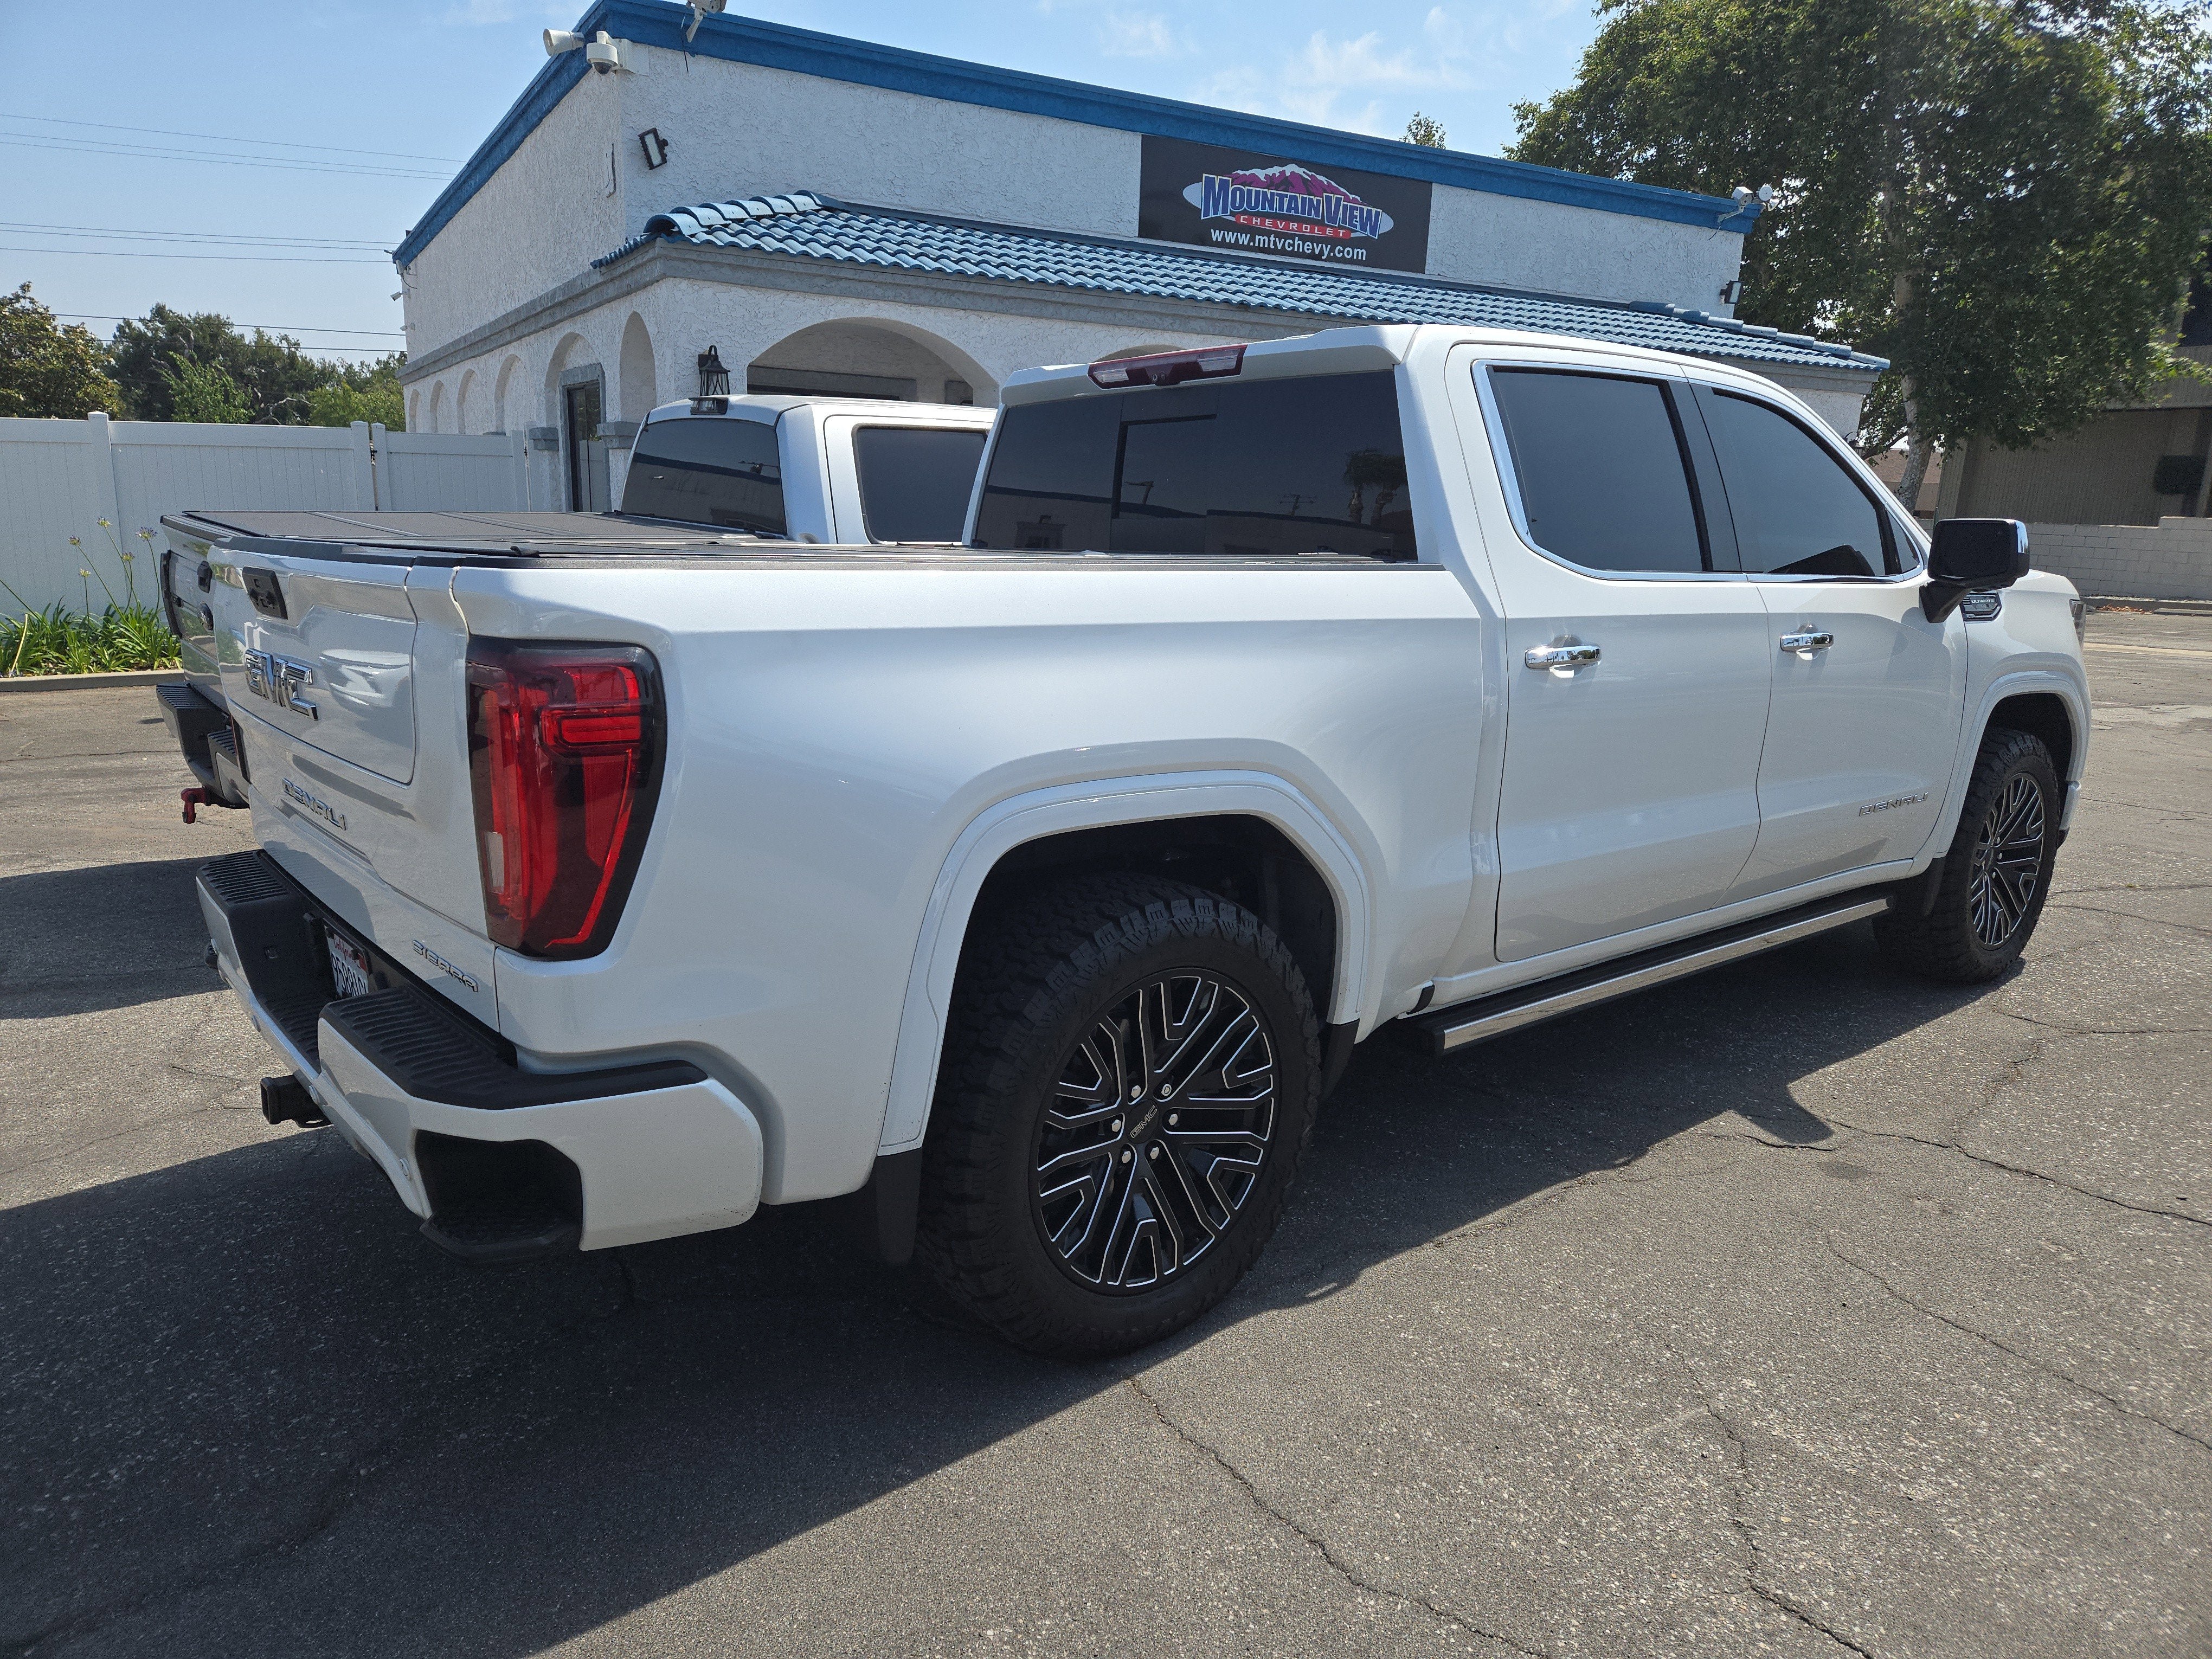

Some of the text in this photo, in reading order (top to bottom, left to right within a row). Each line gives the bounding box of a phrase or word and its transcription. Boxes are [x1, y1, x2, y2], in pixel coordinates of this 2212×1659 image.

[1240, 215, 1345, 237] CHEVROLET
[1211, 229, 1366, 260] www.mtvchevy.com
[246, 648, 318, 721] GMC
[282, 777, 346, 831] DENALI
[1859, 792, 1928, 816] DENALI
[412, 940, 478, 992] SIERRA
[1130, 1104, 1158, 1138] GMC
